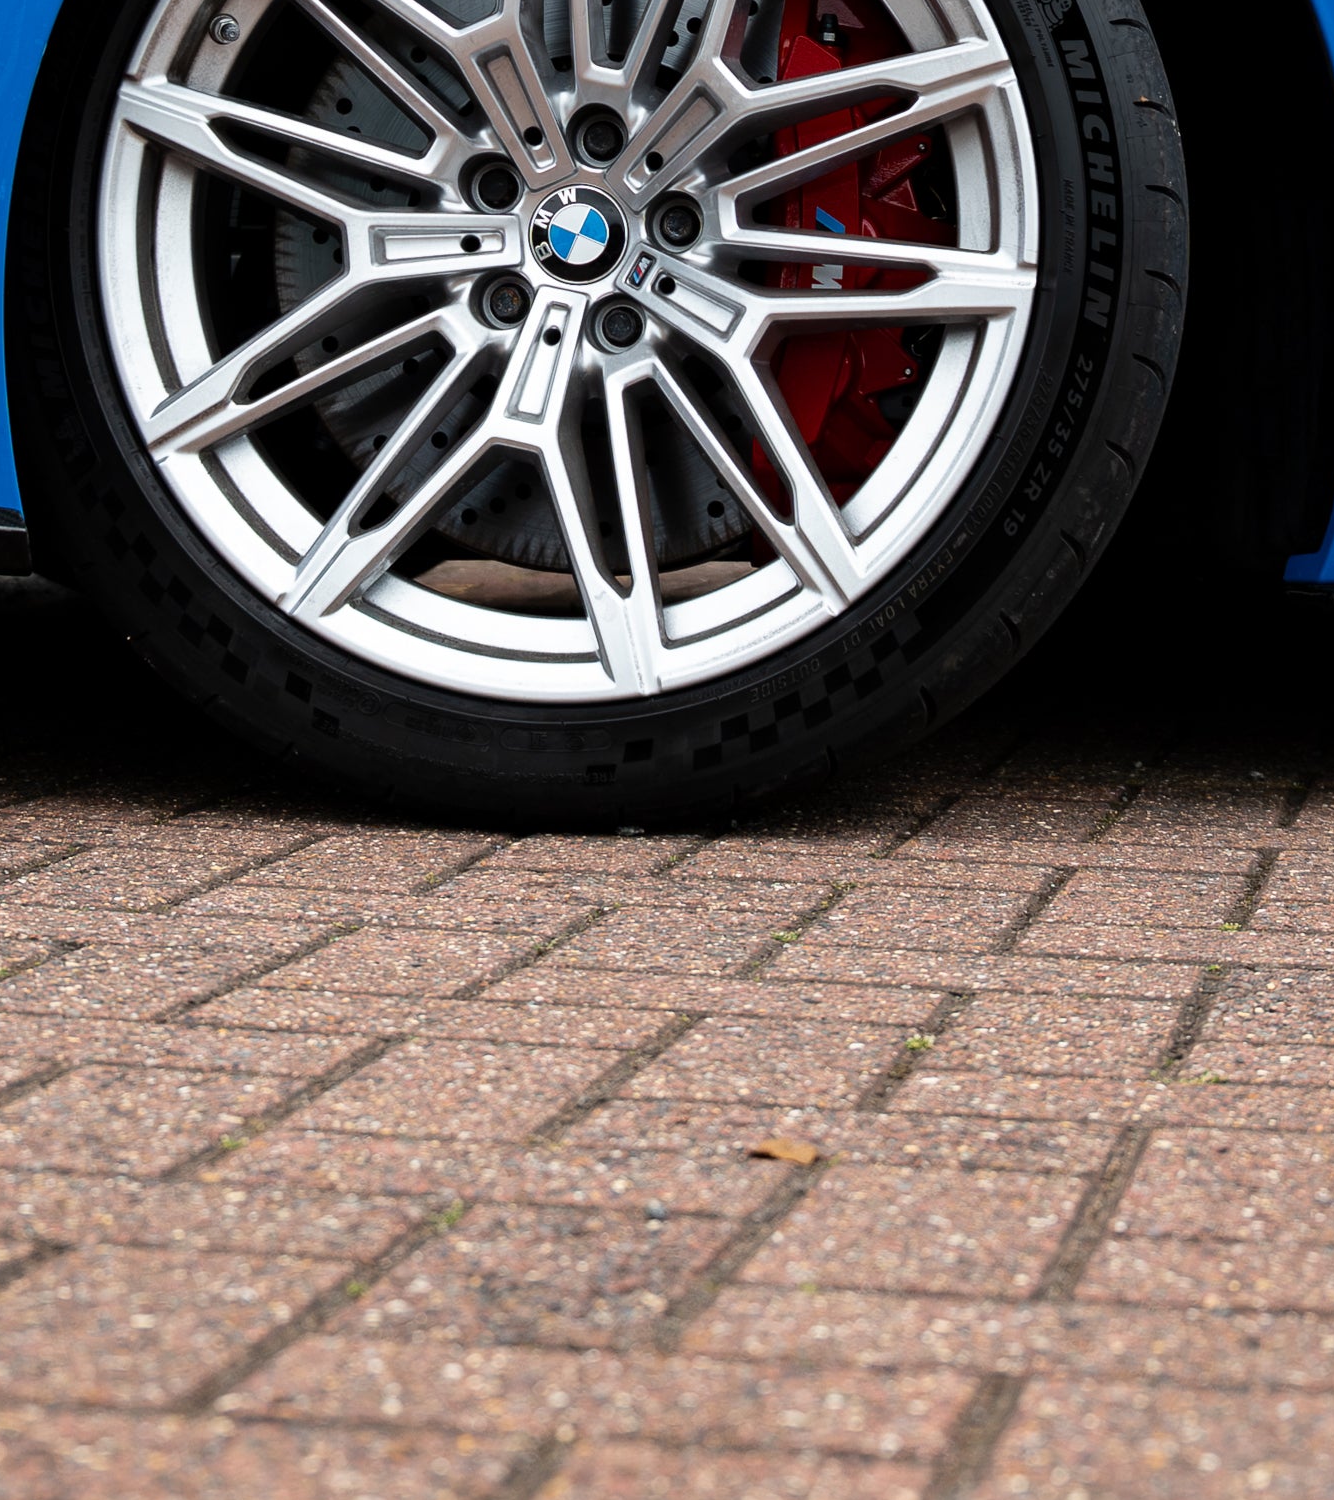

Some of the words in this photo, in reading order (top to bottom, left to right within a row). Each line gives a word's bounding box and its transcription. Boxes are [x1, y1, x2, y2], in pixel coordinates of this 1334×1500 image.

[1060, 39, 1117, 329] MICHELIN
[1062, 176, 1075, 209] MADE
[533, 187, 577, 262] BMW
[1062, 226, 1075, 275] FRANCE
[1048, 353, 1093, 458] 275/35
[1024, 460, 1052, 502] ZR
[1003, 511, 1027, 537] 19
[905, 545, 958, 600] EXTRA
[746, 654, 826, 703] OUTSIDE
